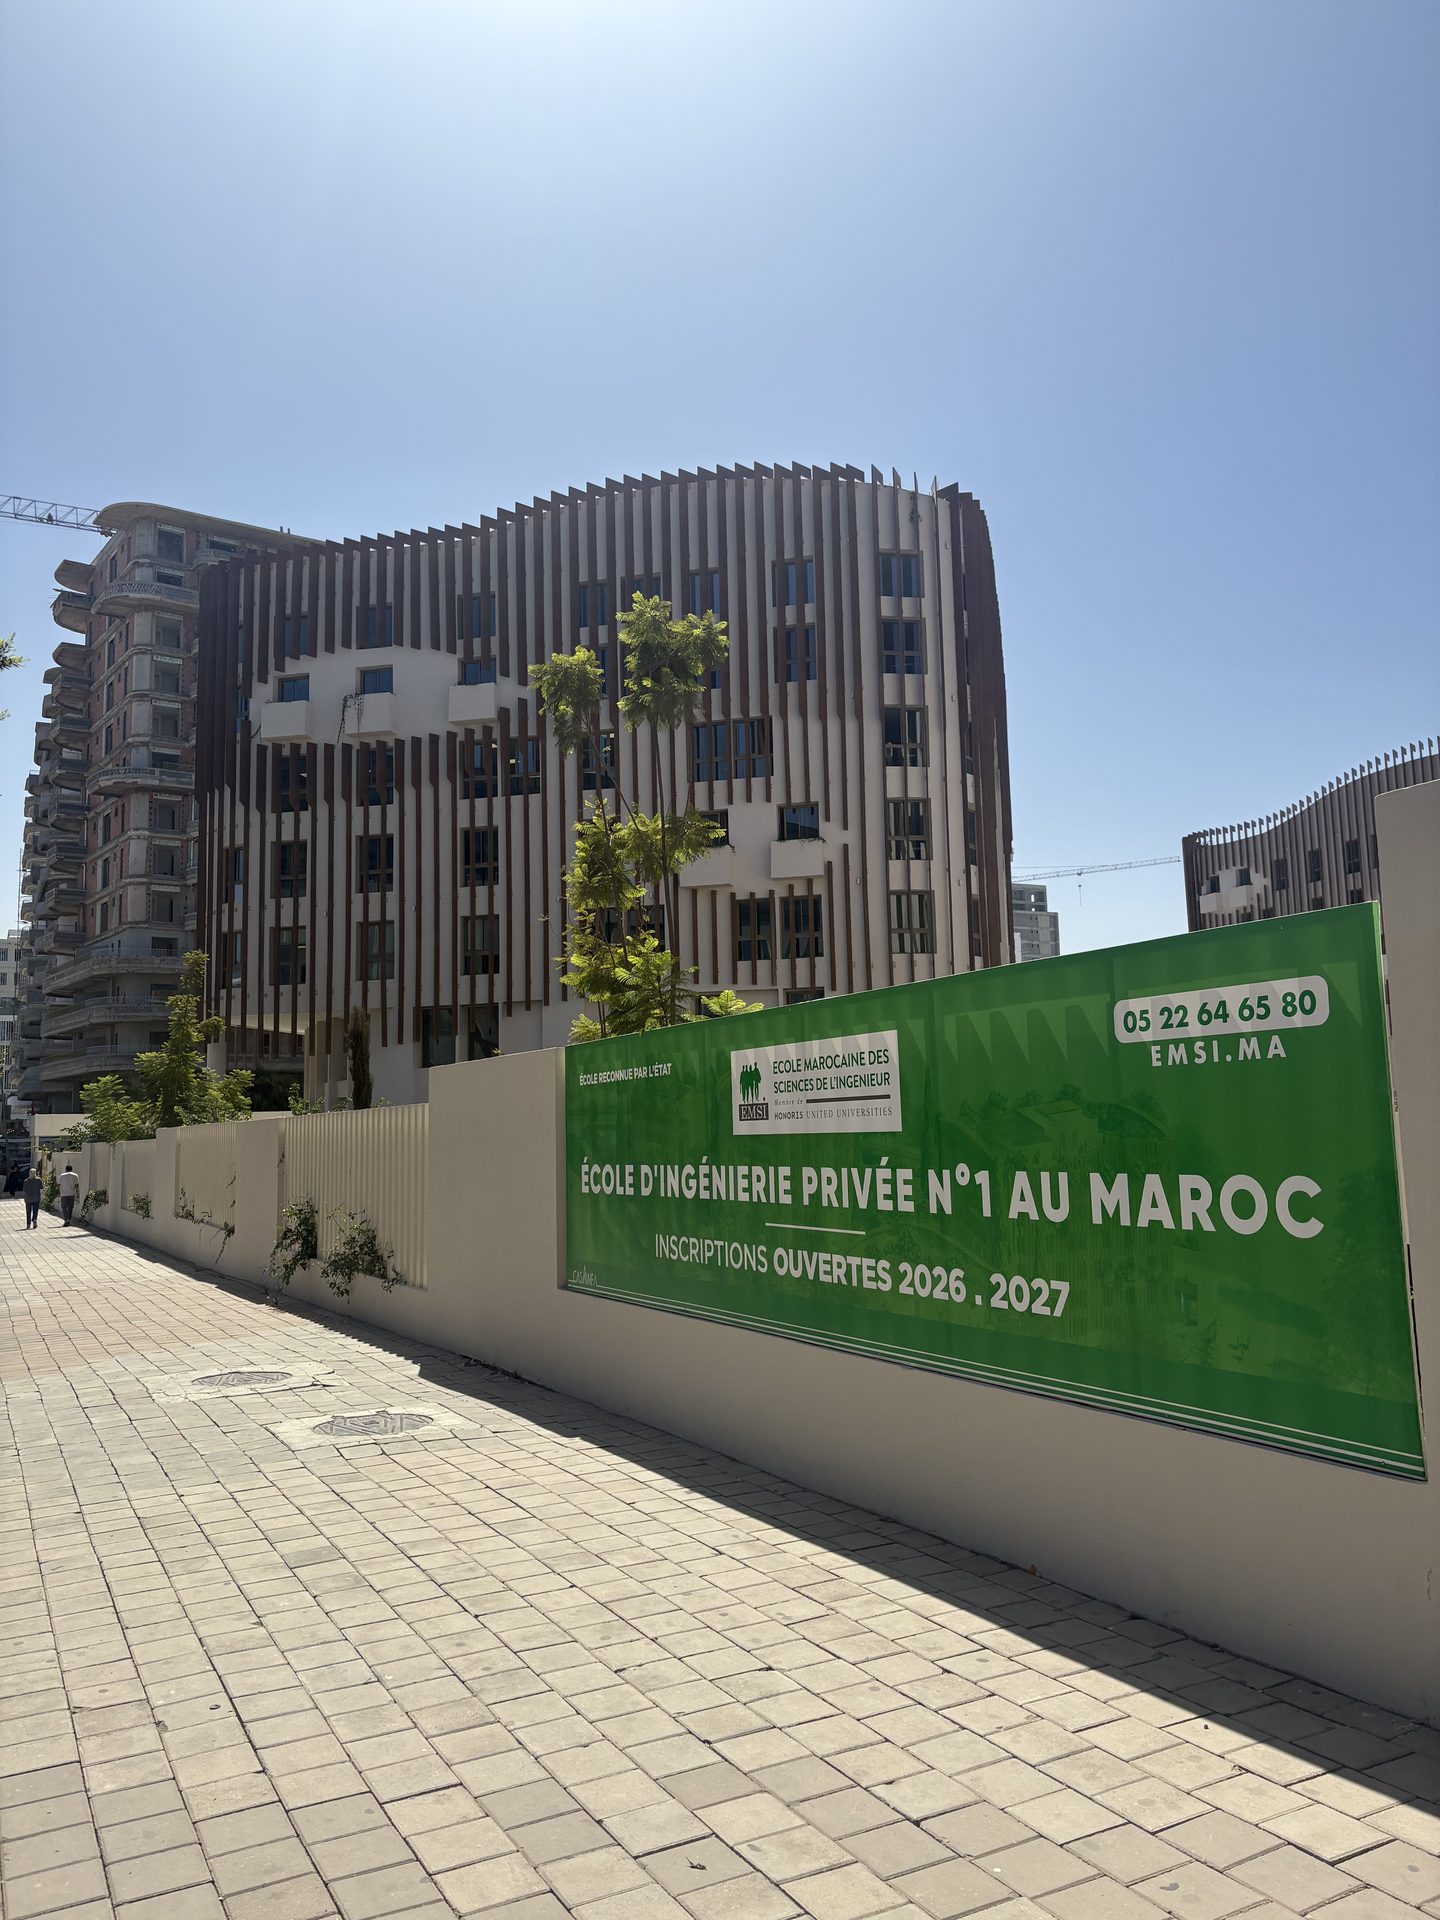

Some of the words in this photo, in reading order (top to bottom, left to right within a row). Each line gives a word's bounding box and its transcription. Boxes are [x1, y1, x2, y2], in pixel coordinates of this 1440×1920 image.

[1123, 1009, 1151, 1034] 05
[1159, 1004, 1189, 1030] 22
[1197, 1000, 1230, 1026] 64
[1238, 995, 1271, 1022] 65
[1281, 989, 1317, 1018] 80
[772, 1058, 802, 1075] ECOLE
[803, 1051, 866, 1072] MAROCAINE
[868, 1048, 890, 1065] DES
[1151, 1034, 1287, 1067] EMSI.MA
[579, 1072, 598, 1086] ÉCOLE
[598, 1068, 633, 1083] RECONNUE
[634, 1066, 648, 1079] PAR
[773, 1077, 814, 1094] SCIENCES
[815, 1076, 828, 1091] DE
[739, 1105, 768, 1120] EMSI
[774, 1110, 803, 1120] HONORIS
[806, 1110, 833, 1119] UNITED
[837, 1106, 893, 1118] UNIVERSITIES
[581, 1157, 634, 1196] ÉCOLE
[640, 1156, 792, 1205] D'INGÉNIERIE
[802, 1156, 915, 1213] PRIVÉE
[1008, 1170, 1070, 1223] AU
[1089, 1173, 1325, 1239] MAROC
[655, 1233, 768, 1274] INSCRIPTIONS
[773, 1247, 893, 1293] OUVERTES
[898, 1261, 967, 1304] 2026
[989, 1272, 1071, 1318] 2027
